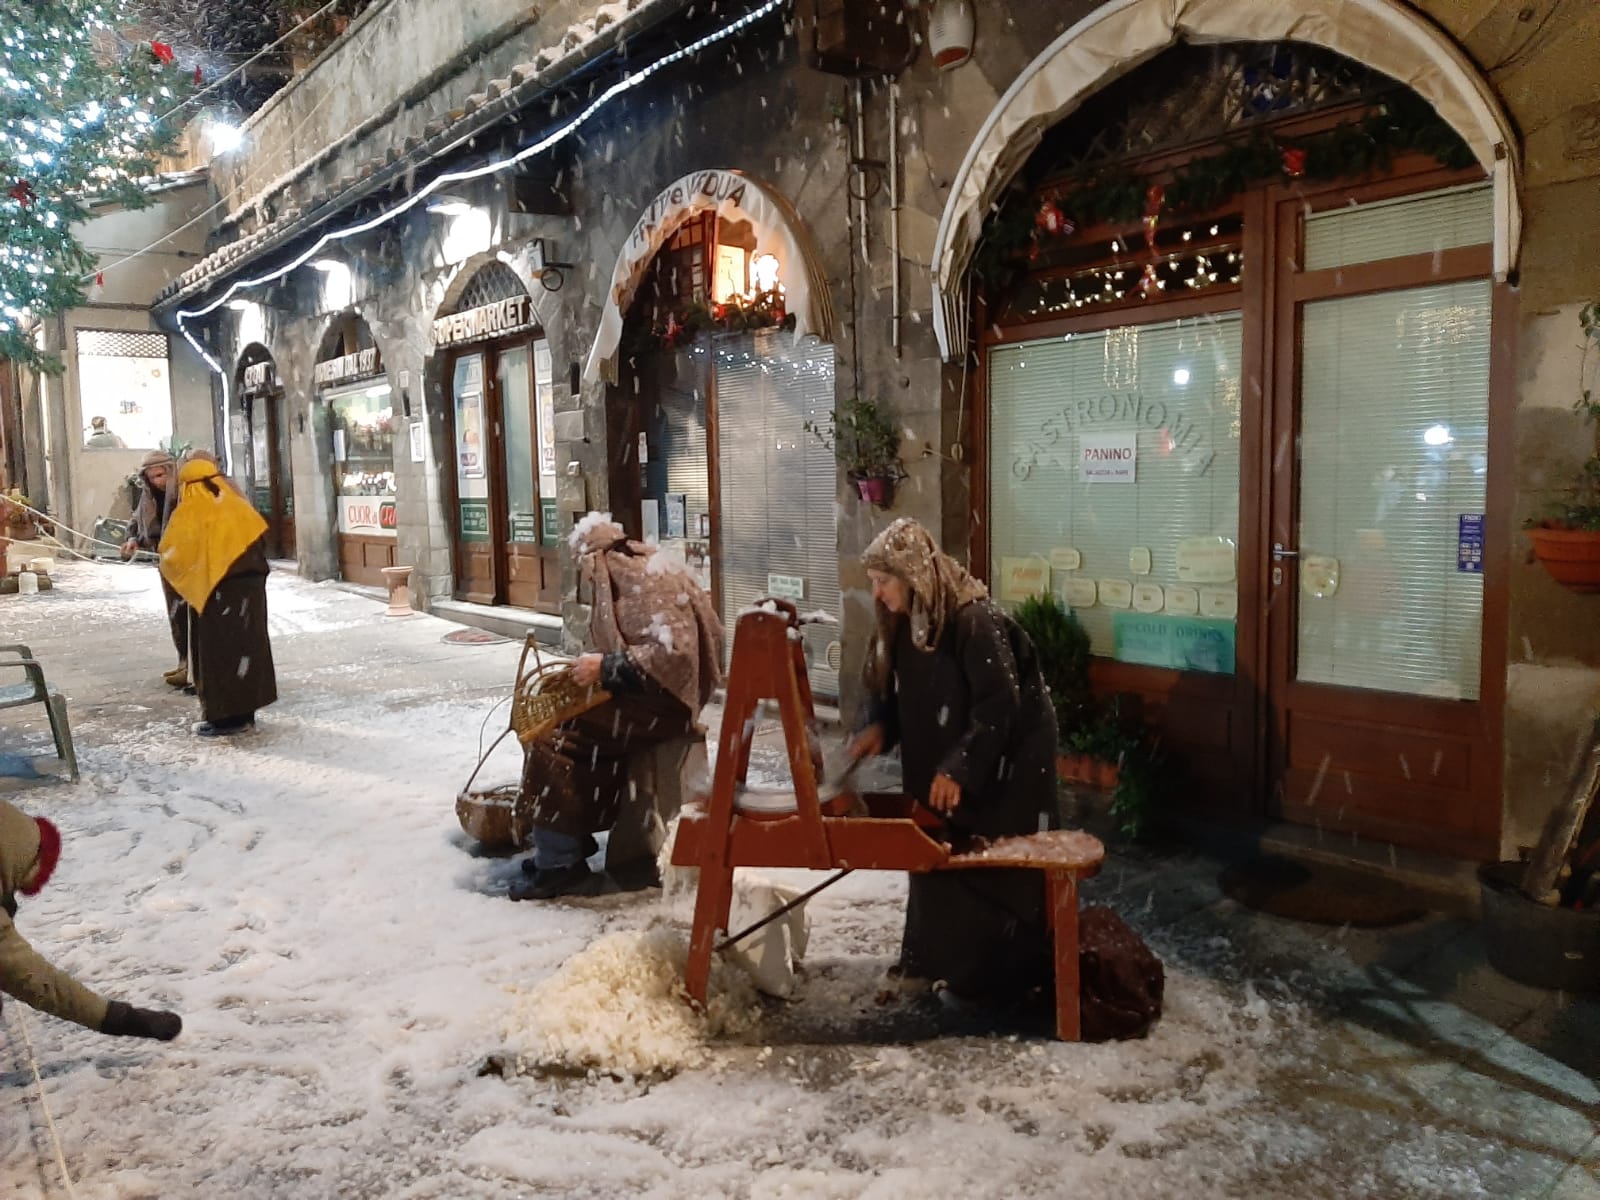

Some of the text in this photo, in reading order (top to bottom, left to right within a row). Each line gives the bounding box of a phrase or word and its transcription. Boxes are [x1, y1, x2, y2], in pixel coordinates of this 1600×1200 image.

[431, 297, 525, 345] SUPERMARKET
[1012, 393, 1216, 481] GASTRONOMIA
[1084, 447, 1132, 460] PANINO
[348, 504, 371, 524] CUOR
